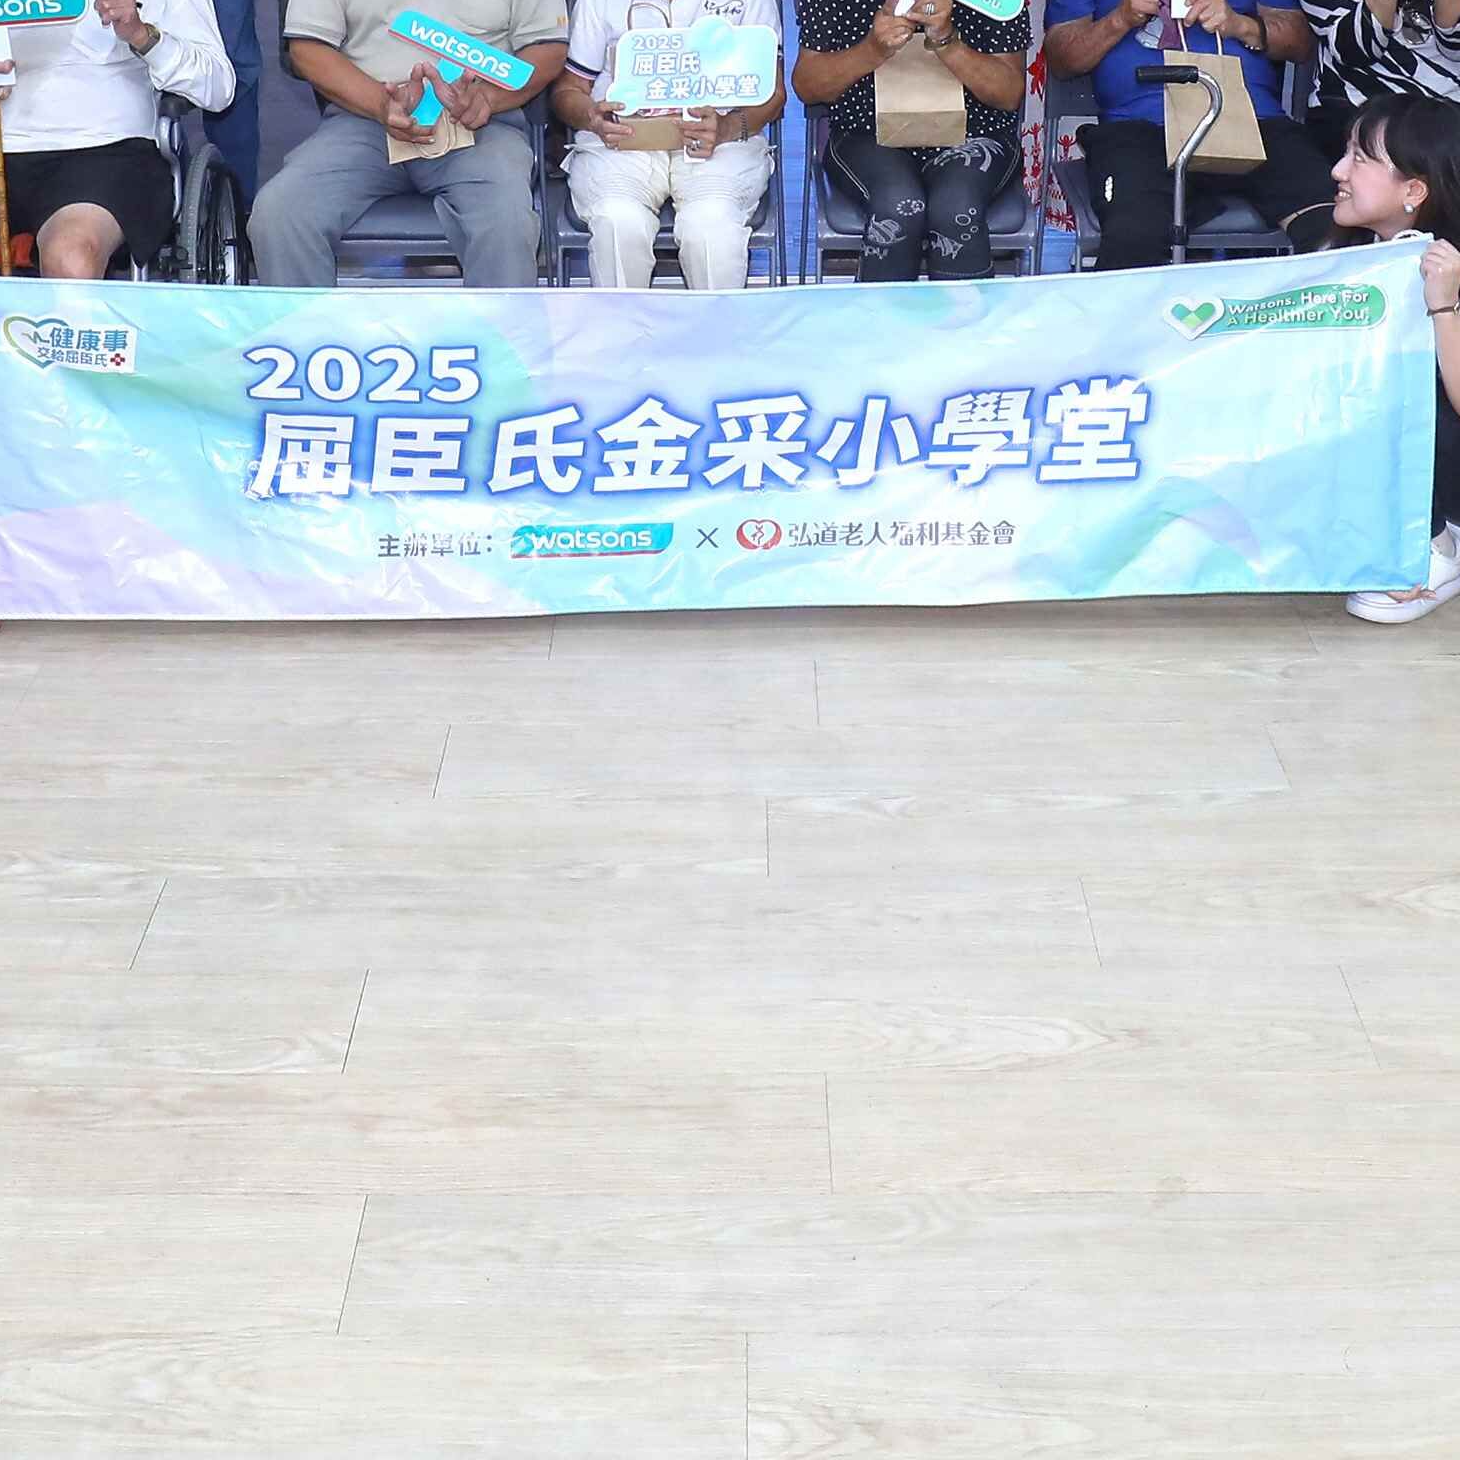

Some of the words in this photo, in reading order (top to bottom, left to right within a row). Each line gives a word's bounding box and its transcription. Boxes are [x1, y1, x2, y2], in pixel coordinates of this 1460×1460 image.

[410, 20, 513, 79] watsons
[633, 35, 683, 50] 2025
[633, 52, 701, 76] 屈臣氏
[646, 75, 761, 100] 金采小學堂
[1227, 297, 1297, 315] Watsons.
[1300, 291, 1338, 305] Here
[1341, 290, 1369, 304] For
[1227, 315, 1238, 326] A
[49, 327, 130, 352] 健康事
[37, 347, 108, 367] 交給屈臣氏
[243, 344, 481, 403] 2025
[246, 376, 1150, 499] 屈臣氏金采小學堂
[530, 529, 653, 551] watsons
[788, 520, 1016, 547] 弘道老人福利基金會
